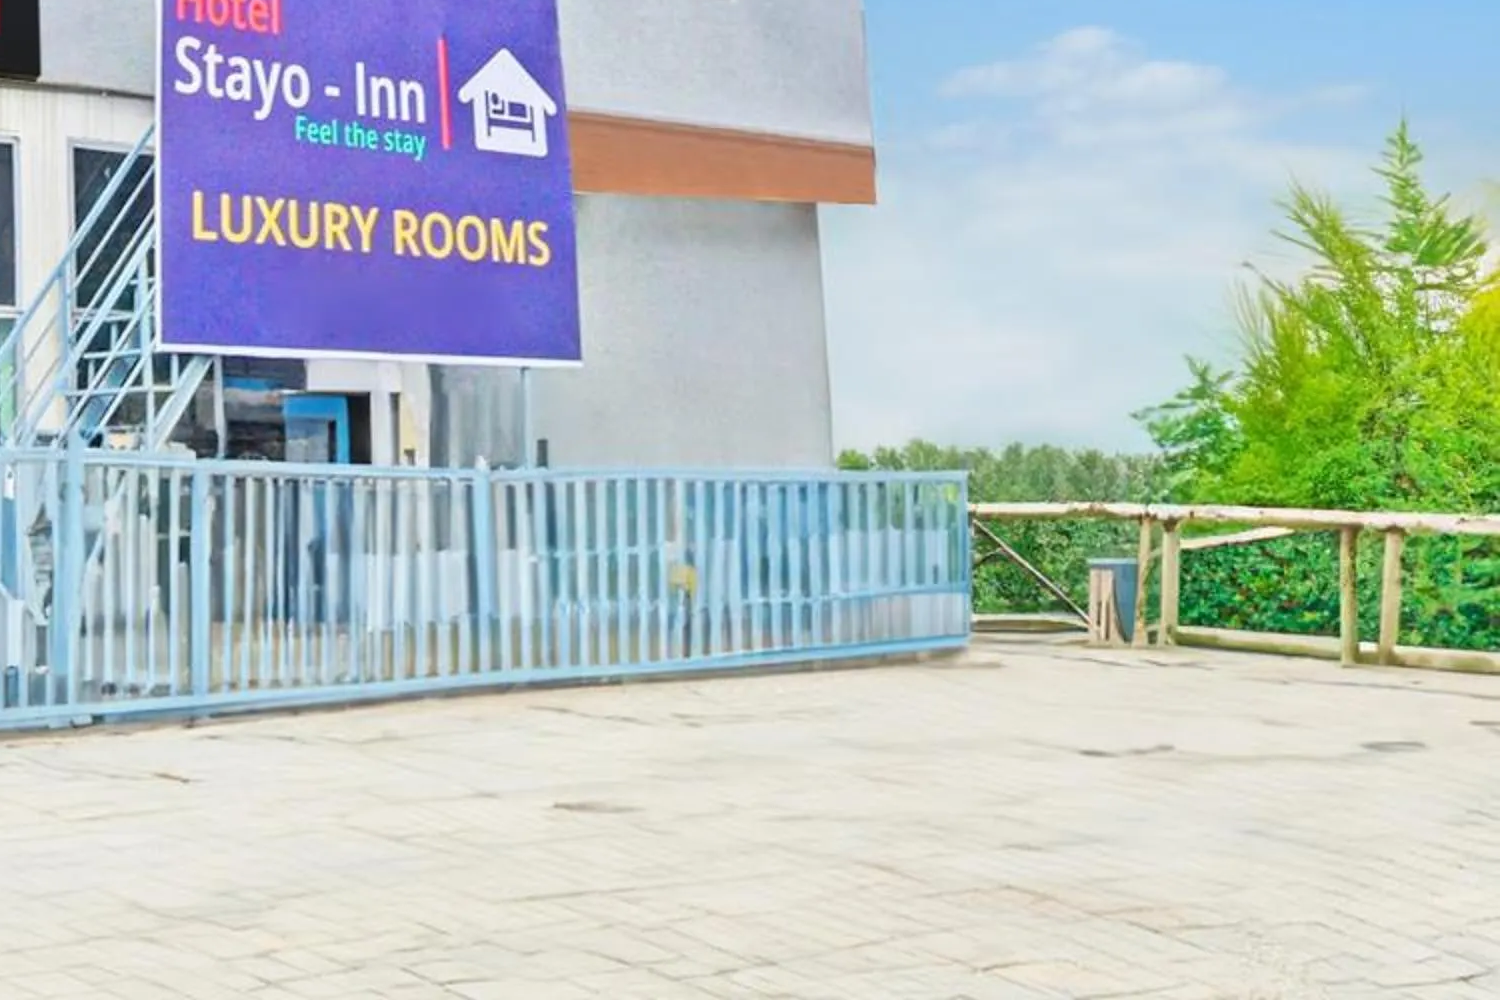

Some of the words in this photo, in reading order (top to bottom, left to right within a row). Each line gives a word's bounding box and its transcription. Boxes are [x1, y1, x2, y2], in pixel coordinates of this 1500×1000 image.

[173, 35, 311, 121] Stayo
[355, 60, 427, 124] Inn
[295, 114, 338, 145] Feel
[344, 119, 379, 150] the
[383, 128, 427, 162] stay
[191, 190, 380, 254] LUXURY
[393, 208, 552, 267] ROOMS
